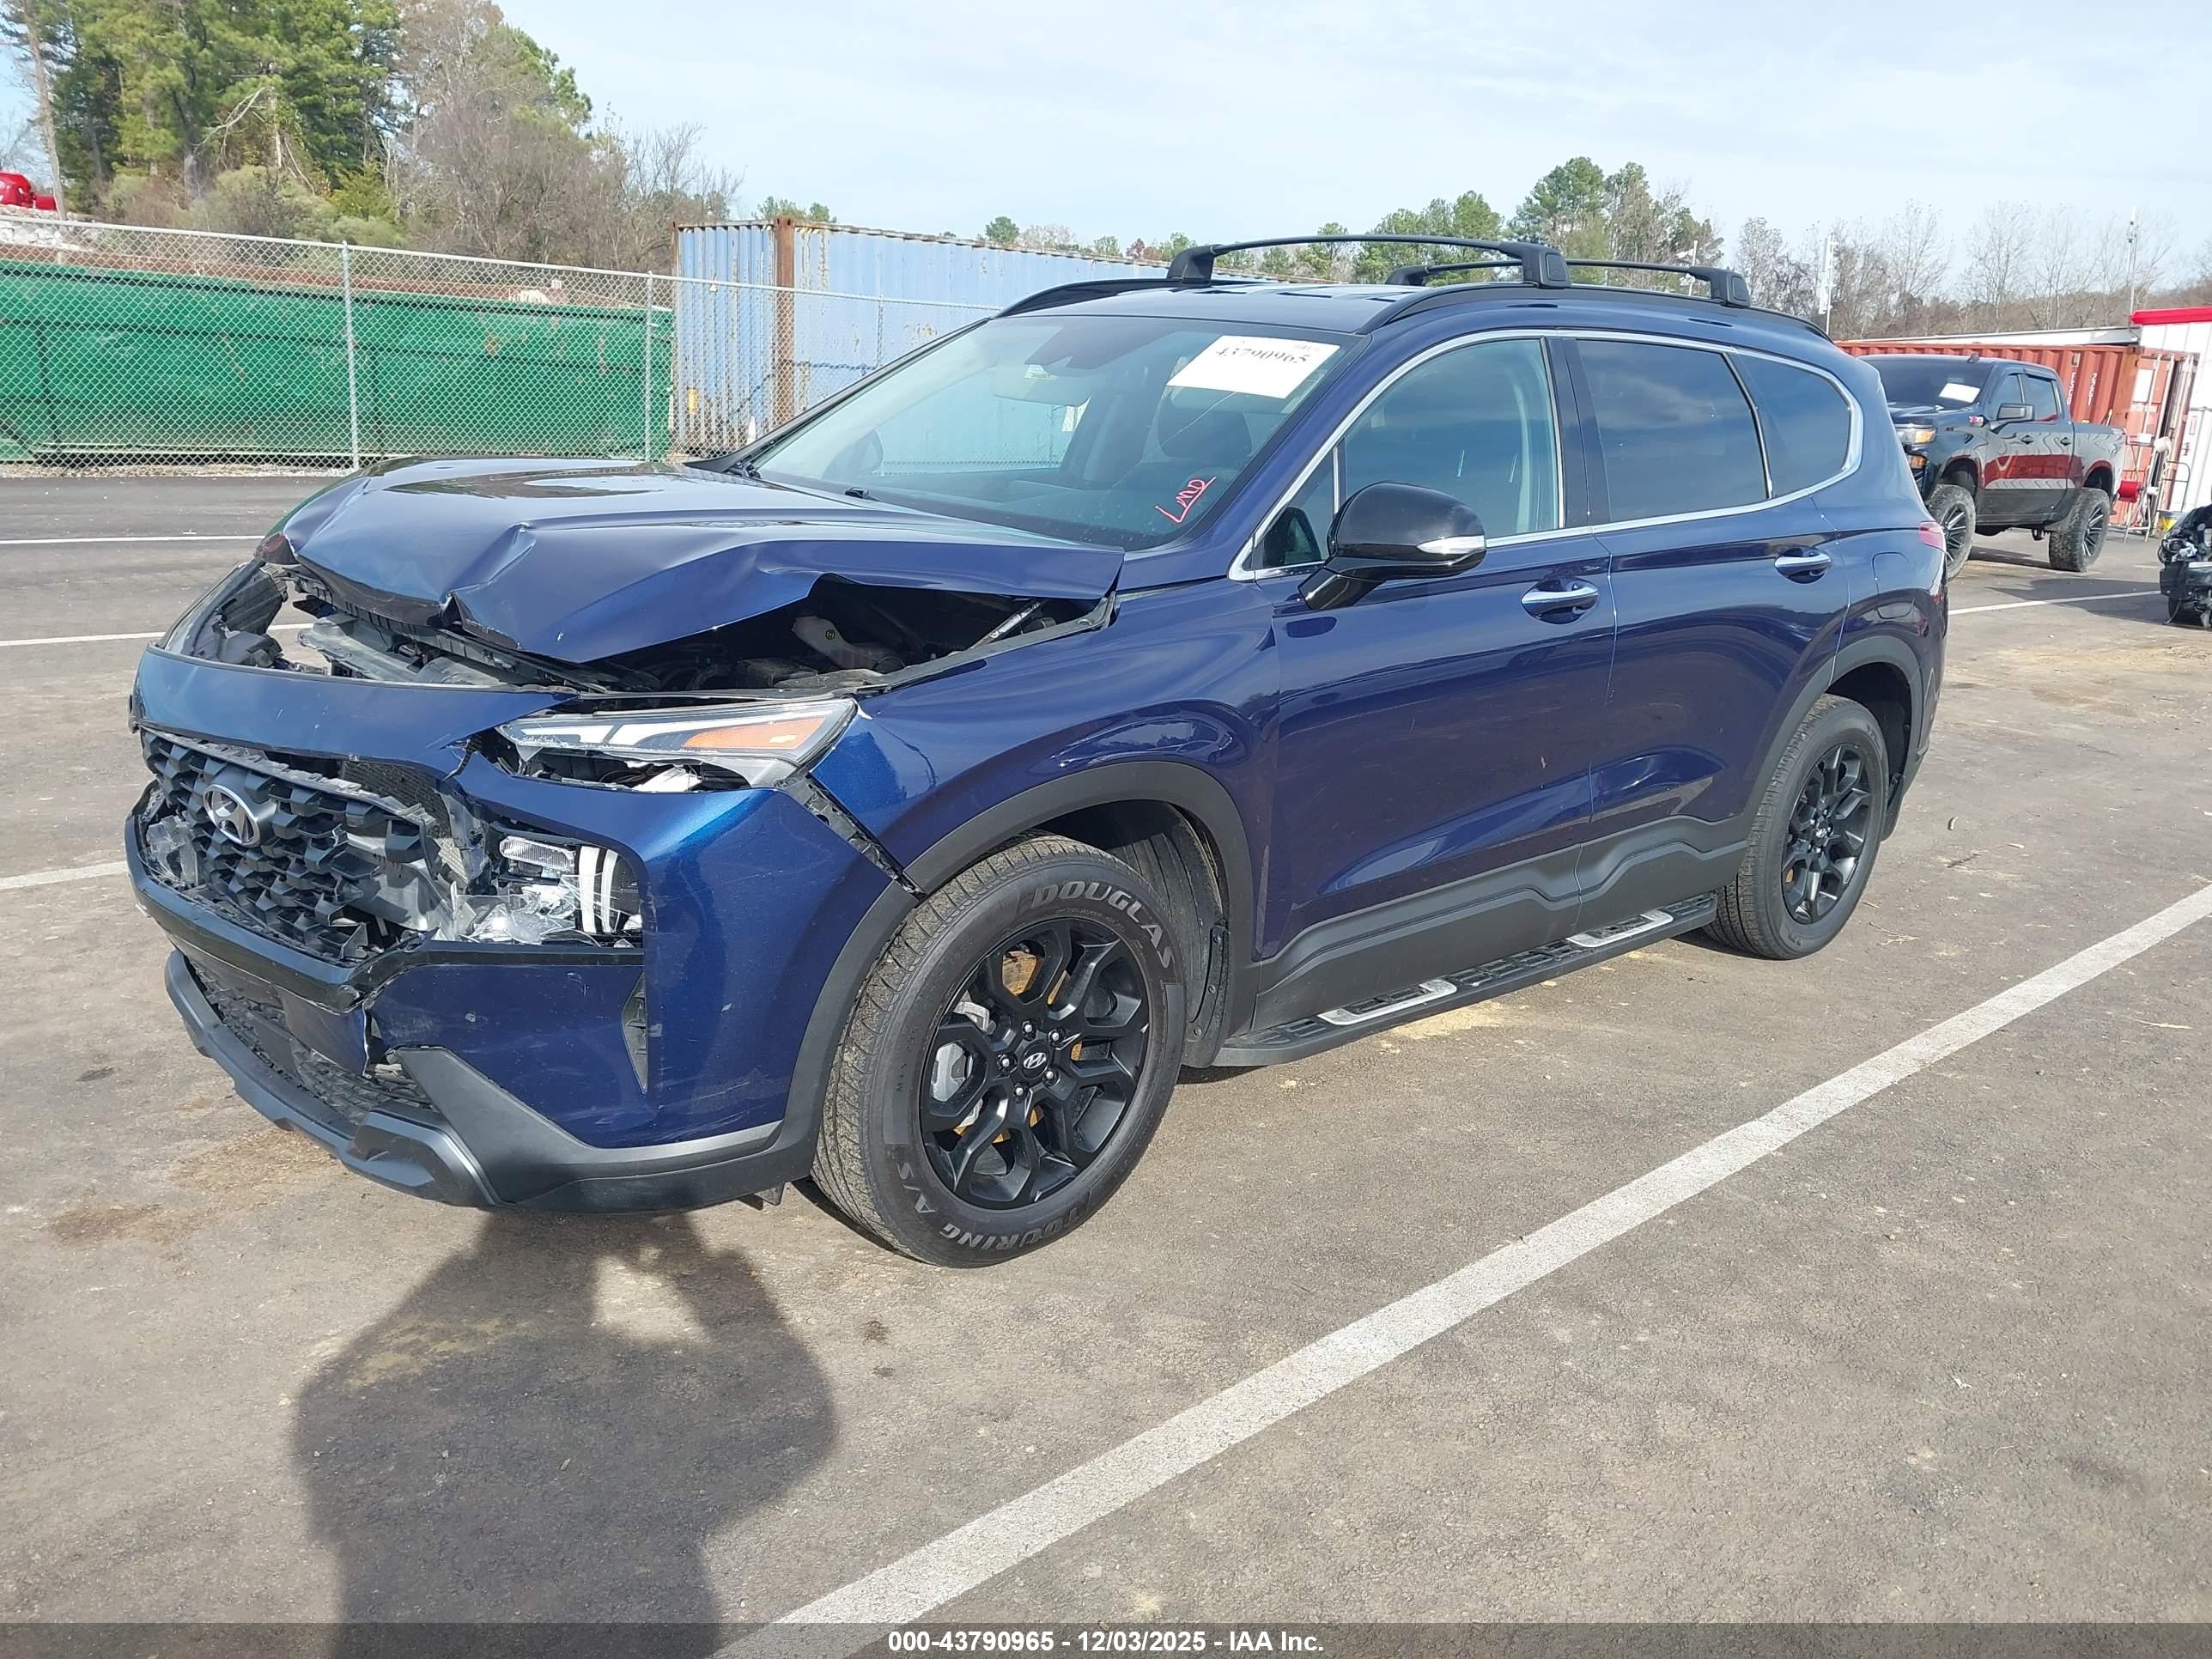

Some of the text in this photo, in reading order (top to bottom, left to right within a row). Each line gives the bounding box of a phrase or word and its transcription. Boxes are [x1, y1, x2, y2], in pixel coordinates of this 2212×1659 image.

[1030, 880, 1175, 969] DOUGLAS
[897, 1163, 1080, 1251] TOURING A/S
